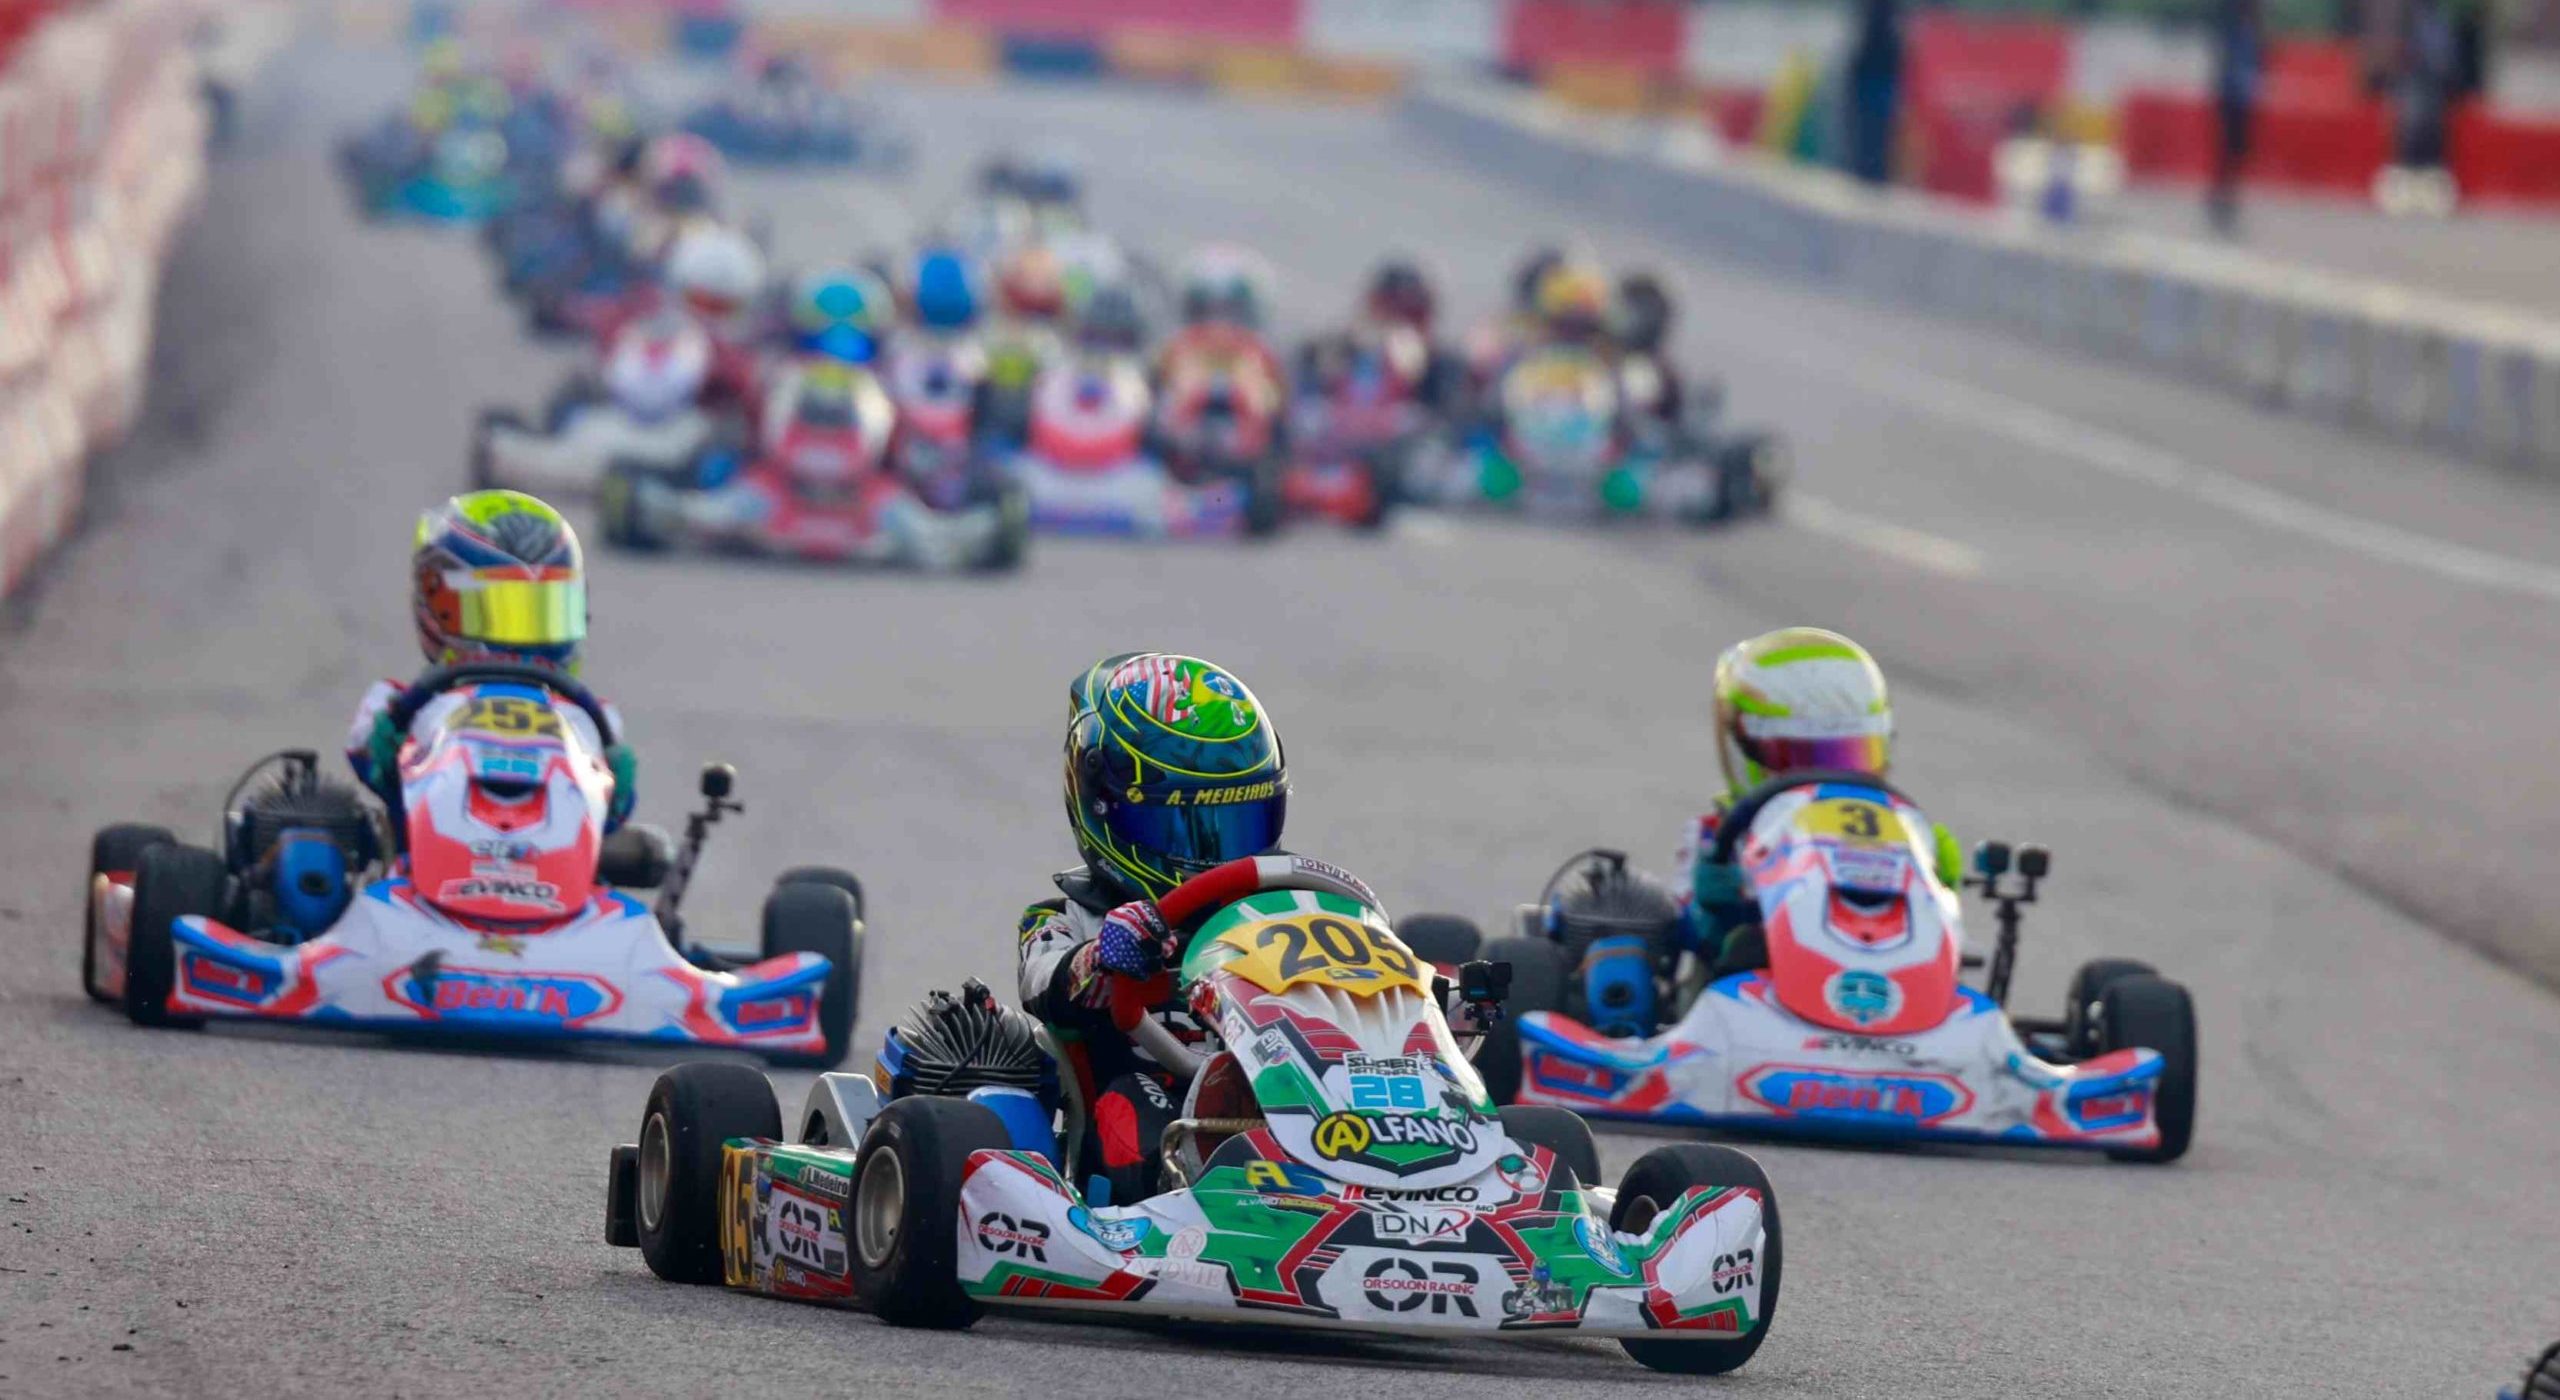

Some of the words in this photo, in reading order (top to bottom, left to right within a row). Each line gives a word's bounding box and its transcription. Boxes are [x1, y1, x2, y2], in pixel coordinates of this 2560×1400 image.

[451, 699, 563, 736] 252
[1166, 790, 1186, 805] A.
[1194, 781, 1275, 805] MEDEIROS
[1841, 804, 1880, 838] 3
[1256, 918, 1419, 981] 205
[1350, 1076, 1426, 1109] 28
[1313, 1112, 1478, 1160] ALFANO
[1363, 1186, 1479, 1203] EVINCO
[979, 1212, 1050, 1263] OR
[1382, 1213, 1461, 1237] DNA
[1363, 1279, 1427, 1290] ORSOLON
[1428, 1281, 1475, 1295] RACING
[1363, 1257, 1480, 1318] OR
[1712, 1248, 1754, 1294] OR
